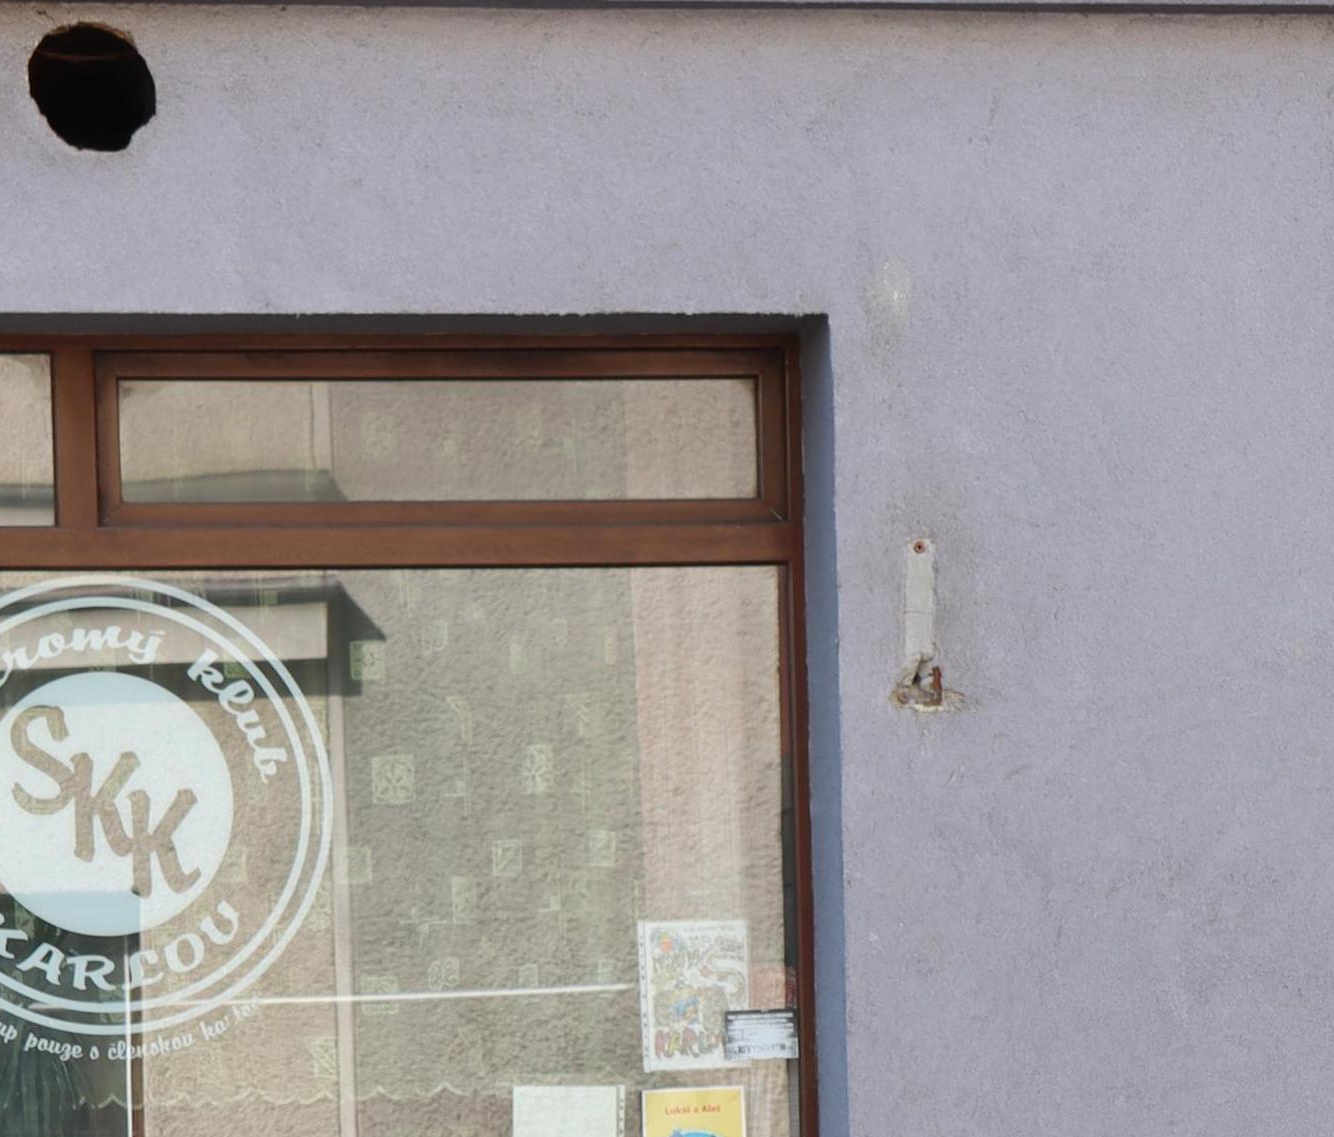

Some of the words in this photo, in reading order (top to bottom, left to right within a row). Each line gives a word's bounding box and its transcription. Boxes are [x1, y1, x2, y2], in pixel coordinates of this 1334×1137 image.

[186, 648, 289, 785] klub
[9, 704, 202, 900] SKK
[24, 1031, 84, 1061] pouze
[89, 1045, 100, 1060] s
